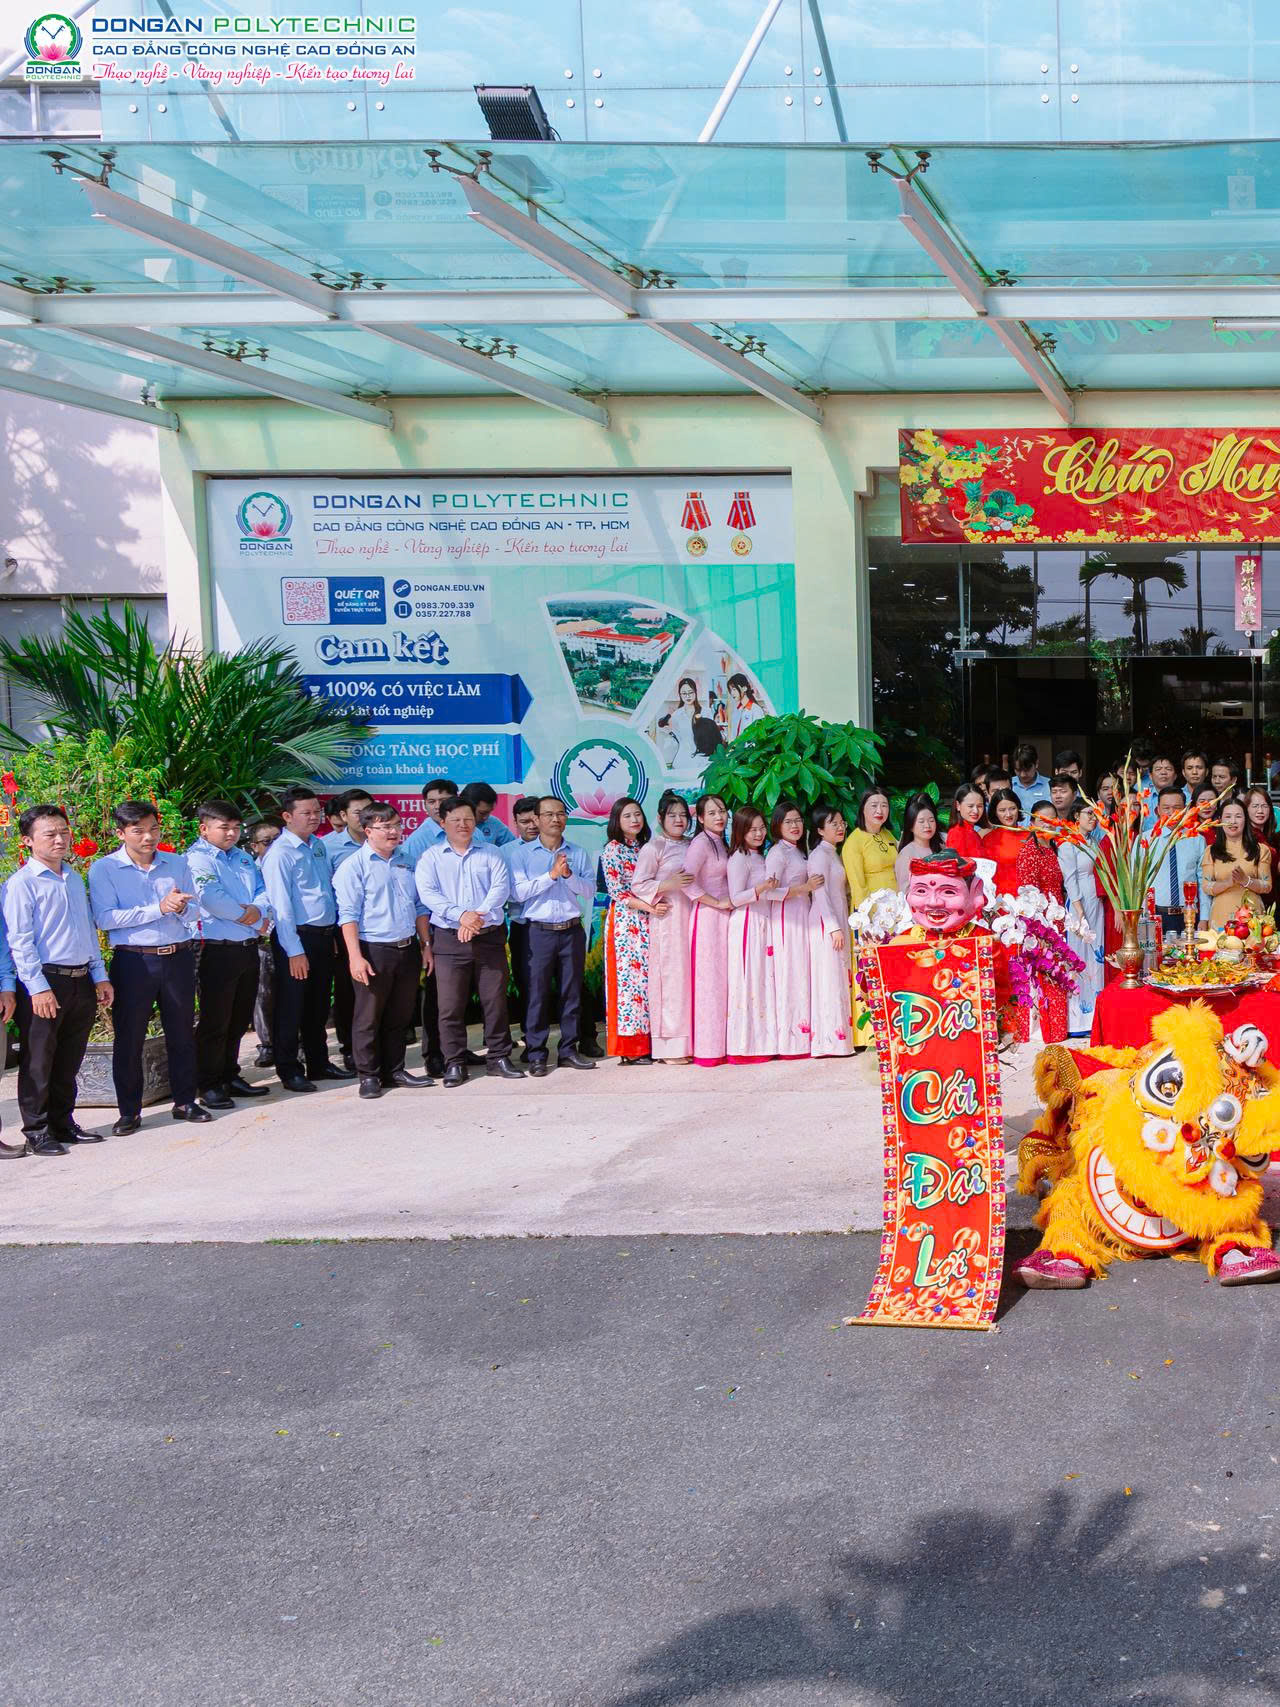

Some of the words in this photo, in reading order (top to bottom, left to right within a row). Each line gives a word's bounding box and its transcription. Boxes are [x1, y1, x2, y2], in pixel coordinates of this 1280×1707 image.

[1042, 436, 1176, 505] Chúc
[313, 495, 420, 509] DONGAN
[432, 493, 629, 507] POLYTECHNIC
[313, 522, 340, 531] CAO
[345, 516, 382, 531] ĐẲNG
[387, 519, 424, 531] CÔNG
[429, 518, 466, 533] NGHỆ
[470, 521, 498, 530] CAO
[502, 516, 541, 530] ĐỒNG
[545, 521, 563, 530] AN
[575, 521, 595, 530] TP.
[600, 521, 630, 530] HCM
[315, 539, 355, 557] Thạo
[359, 540, 389, 560] nghề
[447, 537, 490, 560] nghiệp
[504, 537, 539, 555] Kiến
[544, 541, 565, 555] tạo
[334, 588, 362, 600] QUÉT
[365, 589, 379, 600] QR
[414, 584, 485, 592] DONGAN.EDU.VN
[415, 602, 475, 610] 0983.709.339
[415, 610, 472, 618] 0357.227.788
[314, 635, 388, 664] Cam
[393, 630, 449, 665] kết
[326, 681, 376, 697] 100%
[381, 682, 403, 696] CÓ
[406, 681, 444, 699] VIỆC
[447, 681, 481, 696] LÀM
[372, 704, 391, 716] tốt
[393, 705, 434, 719] nghiệp
[389, 741, 431, 756] TĂNG
[435, 743, 470, 759] HỌC
[472, 740, 500, 756] PHÍ
[366, 763, 391, 774] toàn
[396, 763, 425, 774] khoá
[427, 763, 449, 777] học
[891, 989, 978, 1047] Đại
[900, 1068, 979, 1126] Cát
[902, 1151, 986, 1210] Đại
[913, 1233, 969, 1289] Lợi
